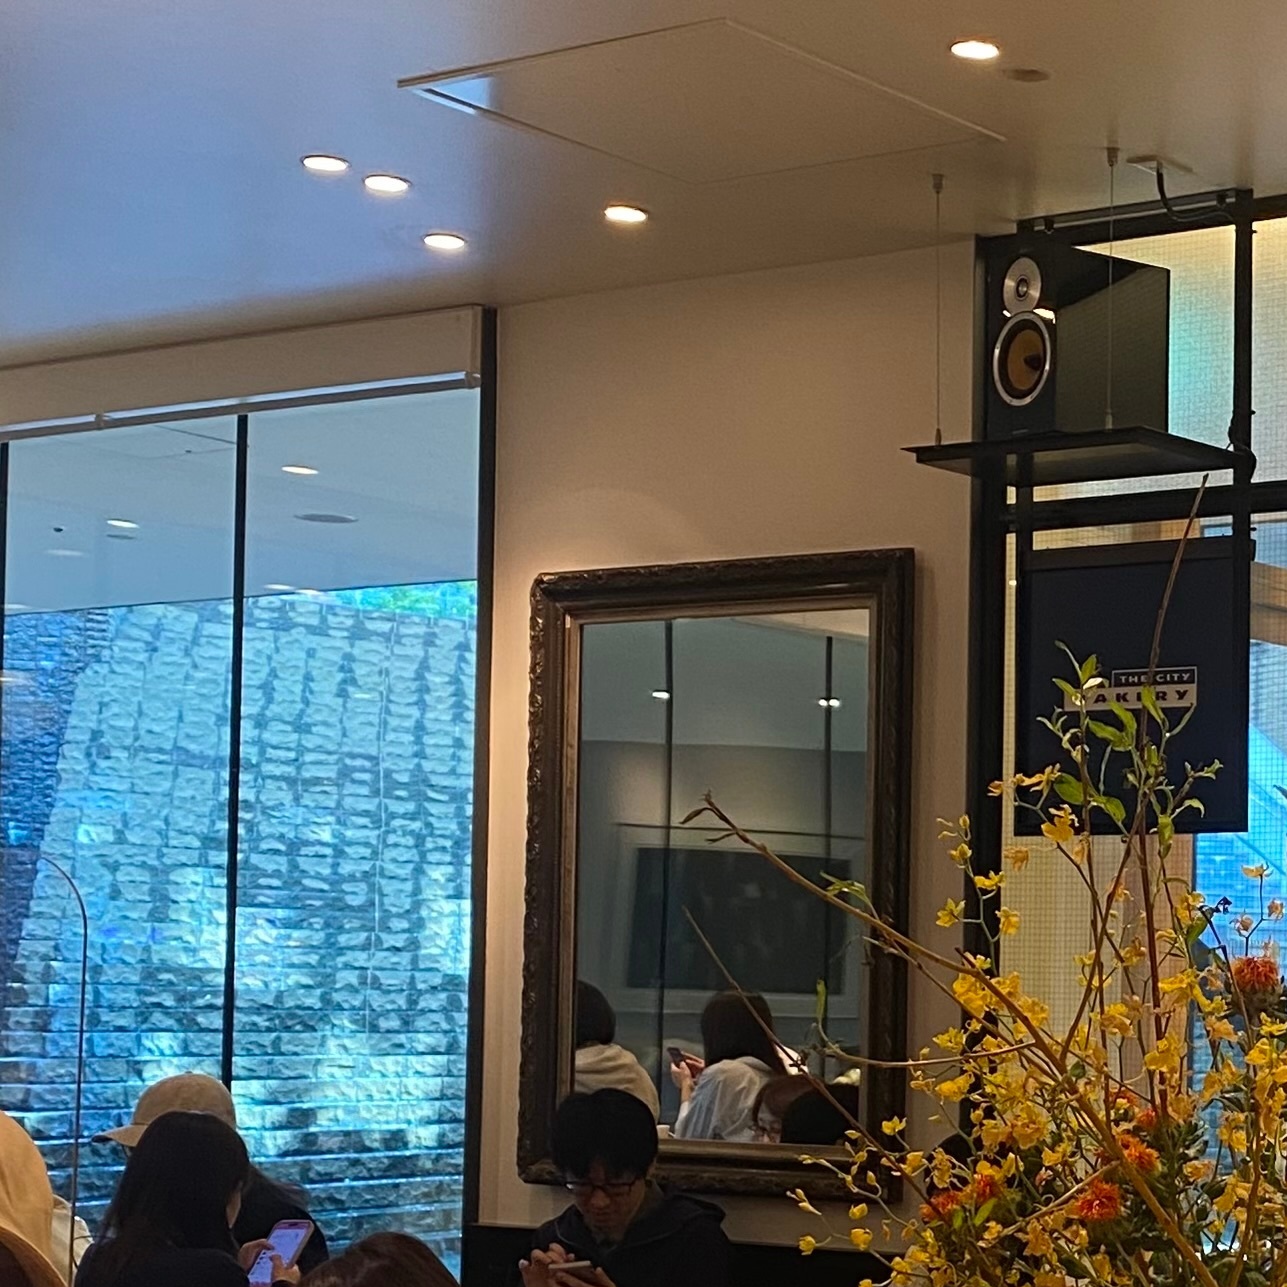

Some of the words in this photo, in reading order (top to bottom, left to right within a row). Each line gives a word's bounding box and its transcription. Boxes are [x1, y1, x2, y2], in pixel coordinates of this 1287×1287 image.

[1119, 674, 1149, 684] THE
[1156, 673, 1191, 682] CITY
[1076, 689, 1189, 704] AKRY
